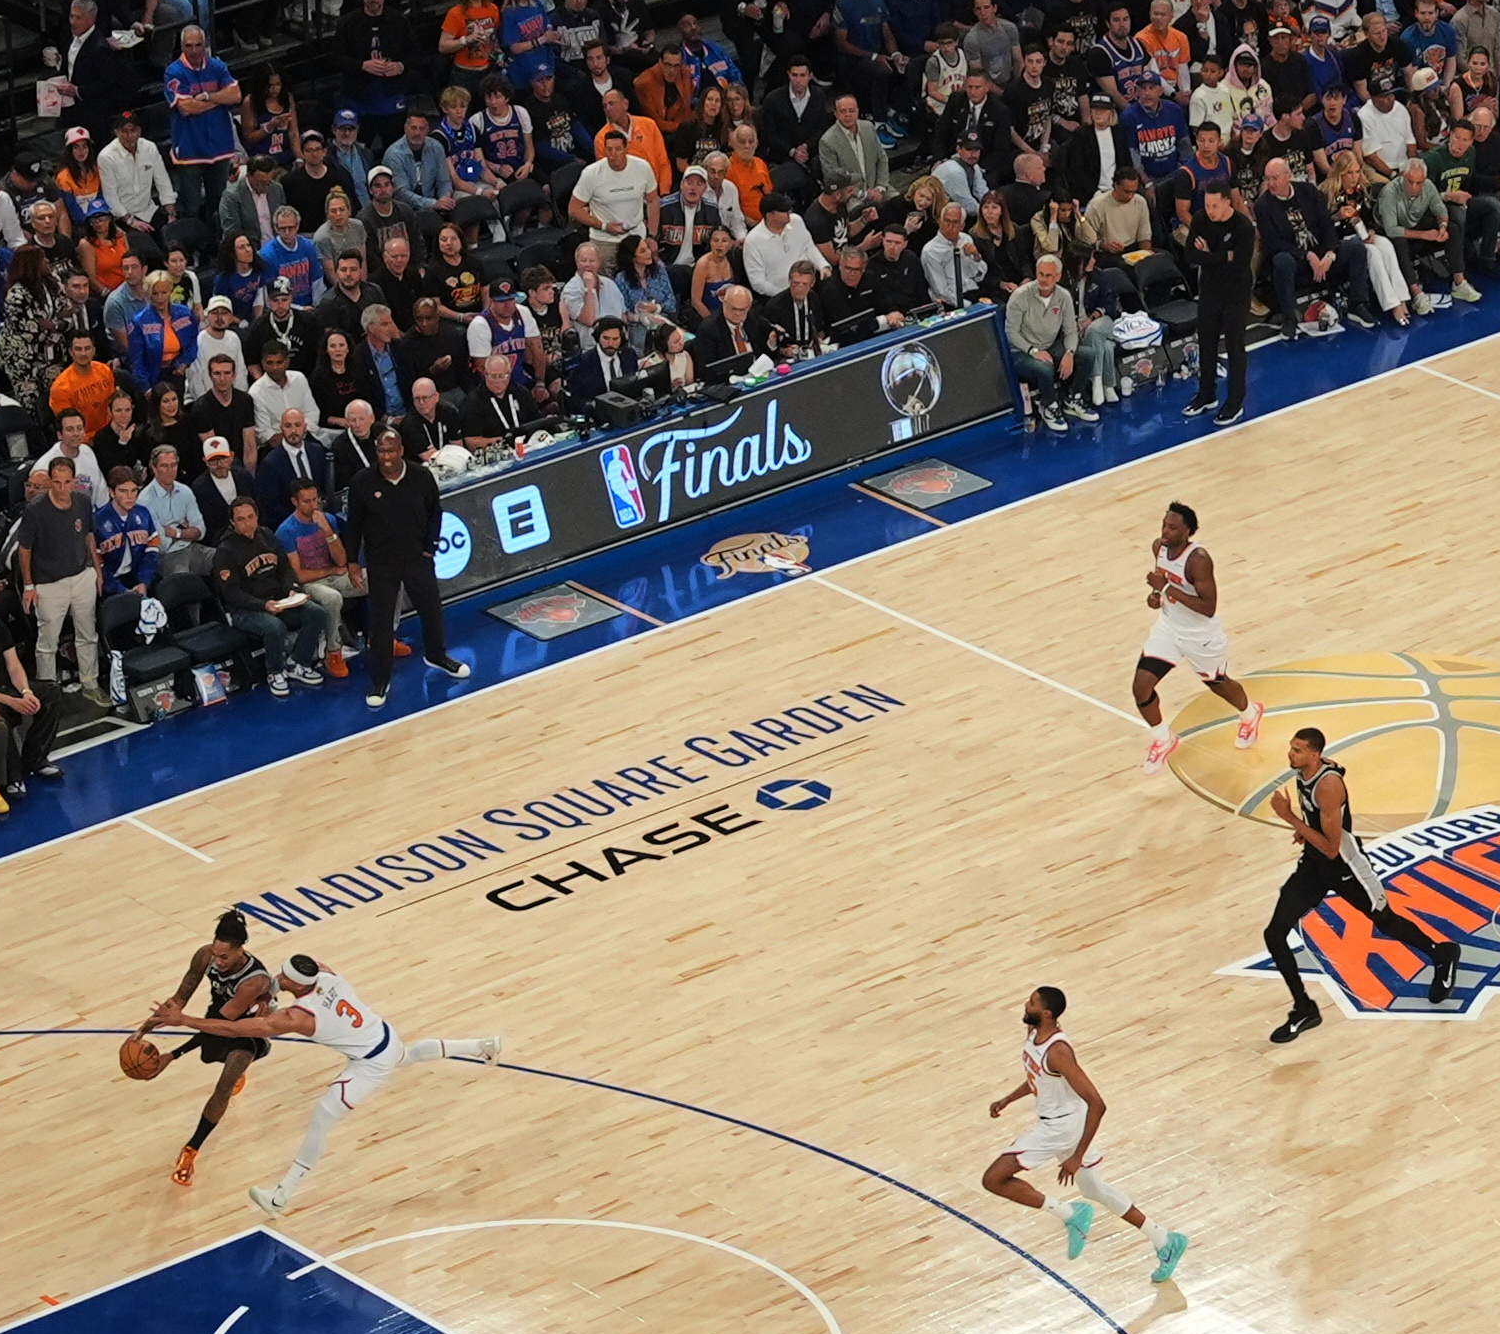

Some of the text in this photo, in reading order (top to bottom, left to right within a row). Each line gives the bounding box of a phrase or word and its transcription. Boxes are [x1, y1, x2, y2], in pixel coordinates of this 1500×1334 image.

[640, 400, 812, 522] Finals
[702, 534, 802, 579] Finals
[235, 683, 906, 933] MADISON SQUARE GARDEN
[484, 802, 762, 912] CHASE
[335, 999, 364, 1029] 3
